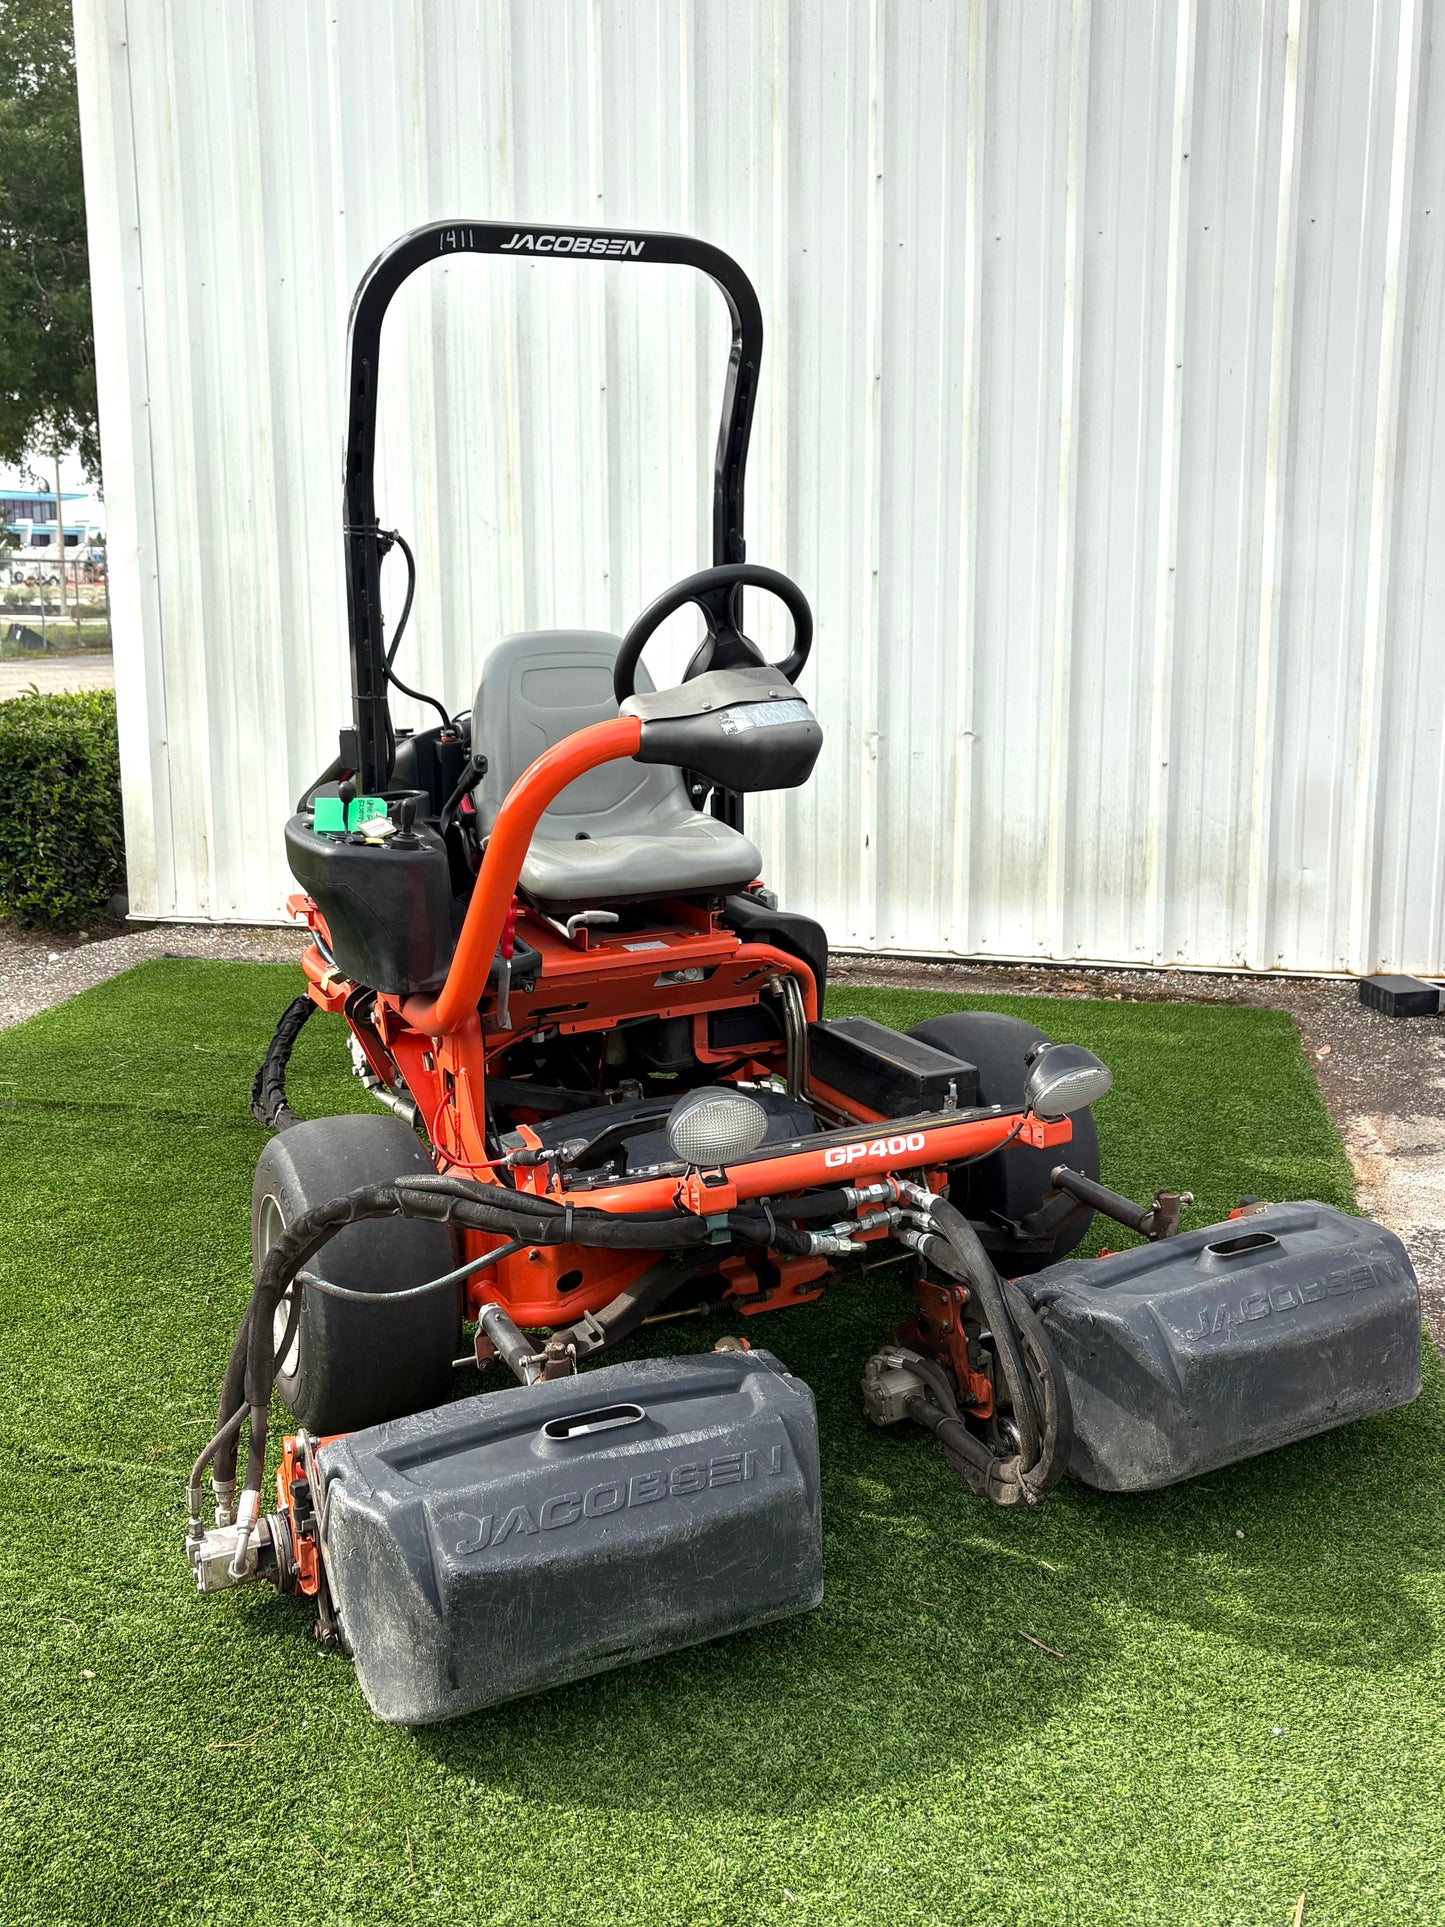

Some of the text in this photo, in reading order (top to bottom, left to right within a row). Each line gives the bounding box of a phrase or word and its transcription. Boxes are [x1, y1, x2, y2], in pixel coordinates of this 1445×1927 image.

[440, 229, 474, 250] 1411
[500, 233, 645, 256] JACOBSEN
[824, 1133, 925, 1168] GP400
[1185, 1261, 1398, 1342] JACOBSEN
[456, 1444, 783, 1556] JACOBSEN
